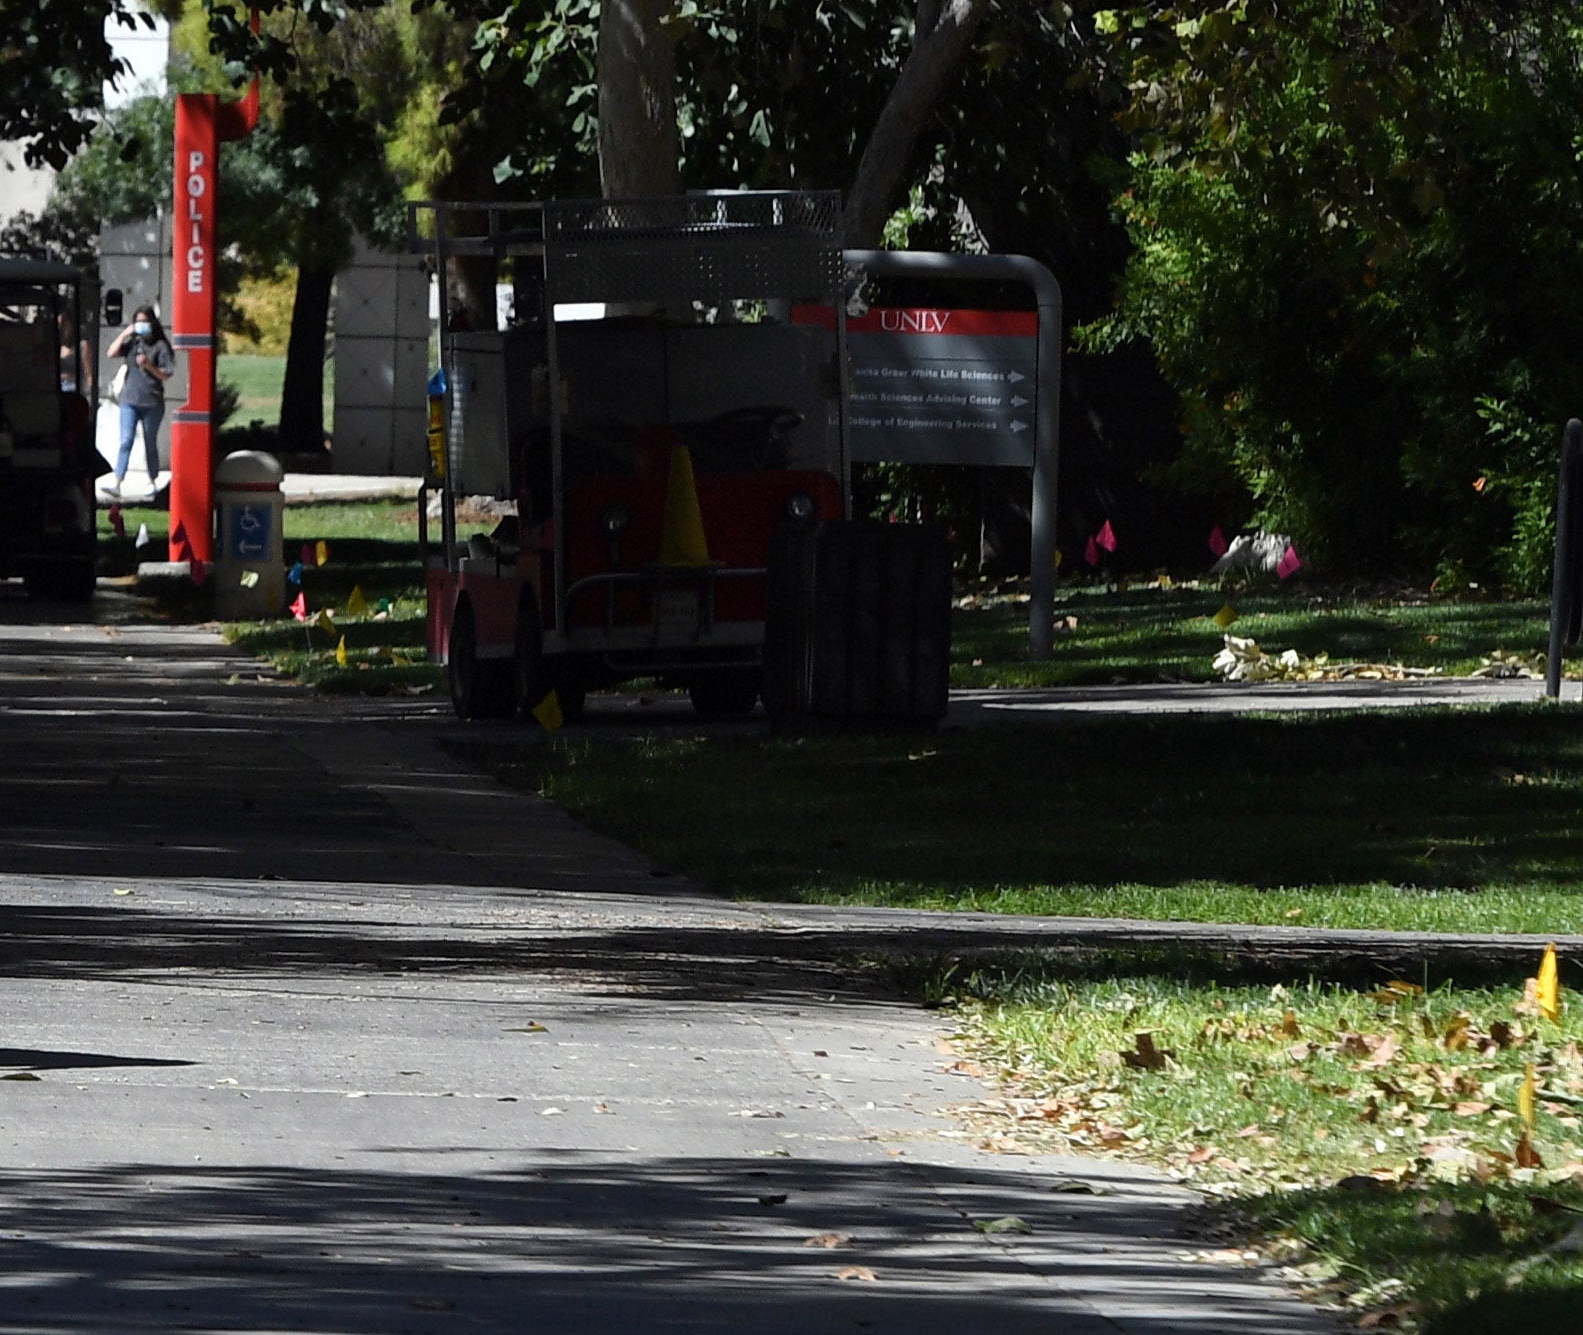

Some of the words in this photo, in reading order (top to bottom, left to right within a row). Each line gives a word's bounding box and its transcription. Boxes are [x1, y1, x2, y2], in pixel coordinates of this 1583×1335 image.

[188, 151, 205, 292] POLICE
[880, 310, 951, 333] UNLV
[910, 368, 938, 378] White
[940, 369, 959, 380] Life
[960, 370, 1005, 381] Sciences
[880, 392, 923, 403] Sciences
[925, 393, 967, 406] Advising
[969, 394, 1002, 405] Center
[896, 417, 953, 430] Engineering
[954, 419, 997, 430] Services
